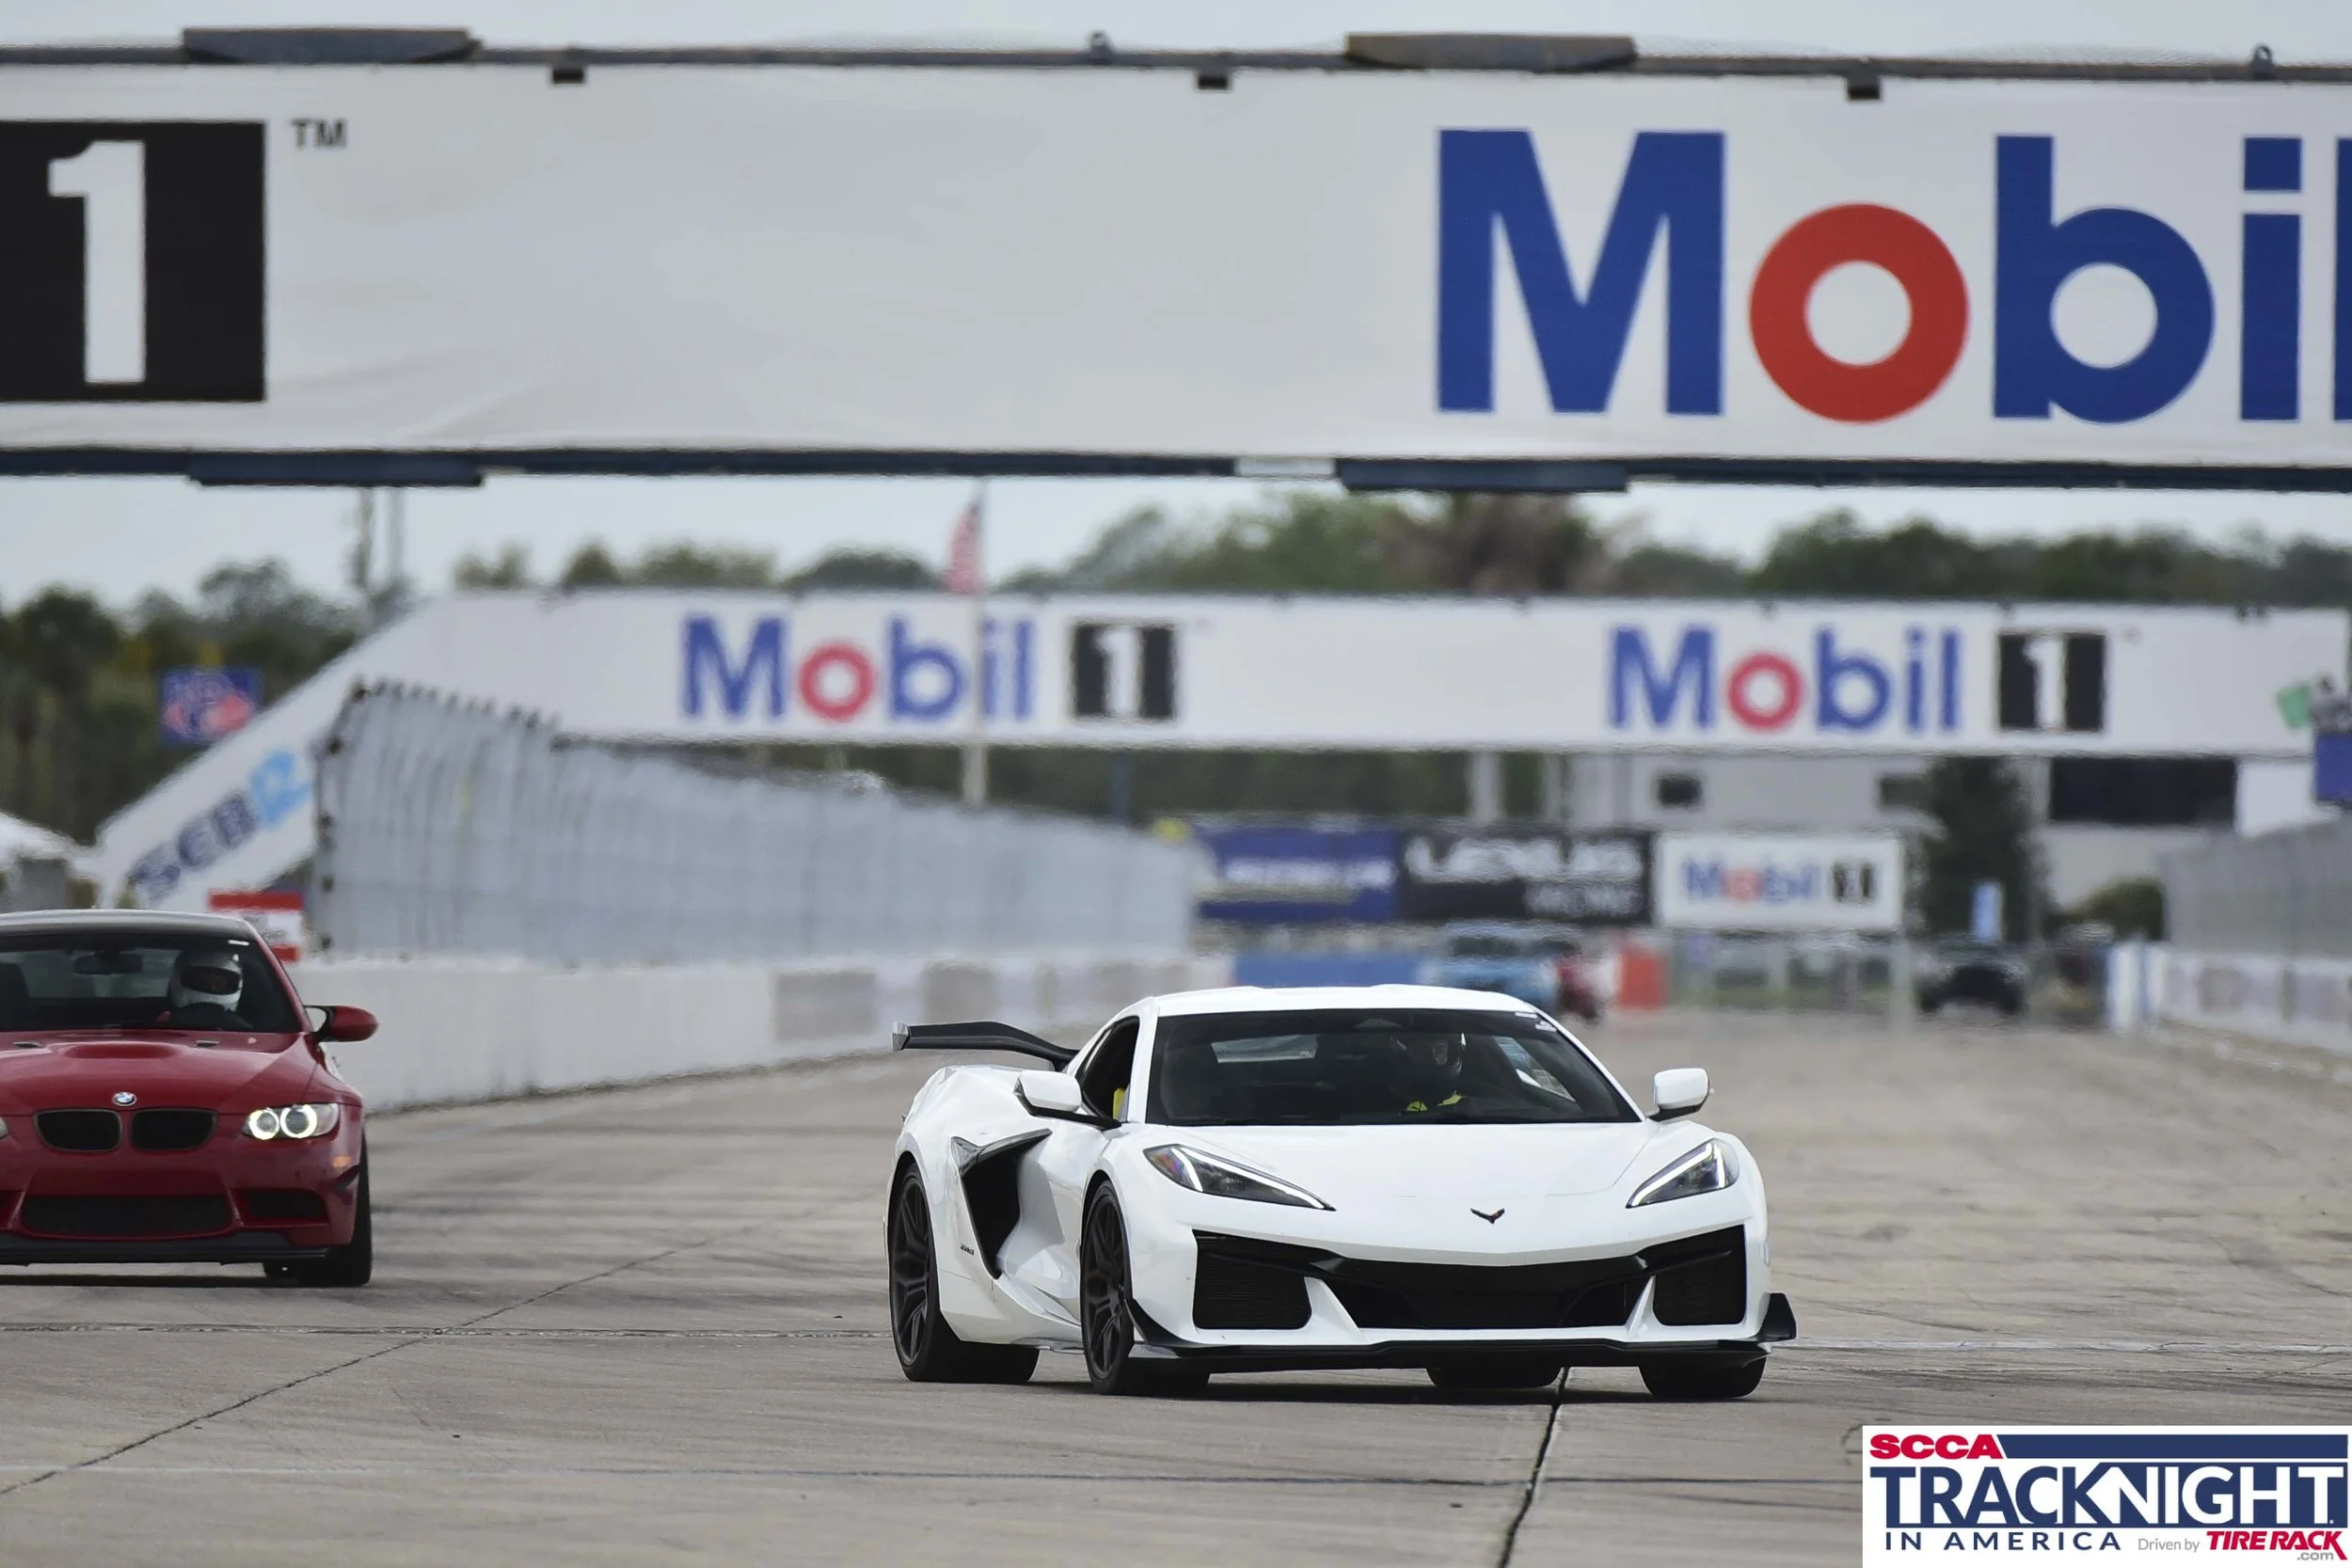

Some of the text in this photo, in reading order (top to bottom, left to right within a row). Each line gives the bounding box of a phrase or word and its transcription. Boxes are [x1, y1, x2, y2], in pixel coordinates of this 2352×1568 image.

[49, 119, 346, 383] 1 TM
[682, 615, 1035, 722] Mobil
[1608, 626, 1963, 732] Mobil
